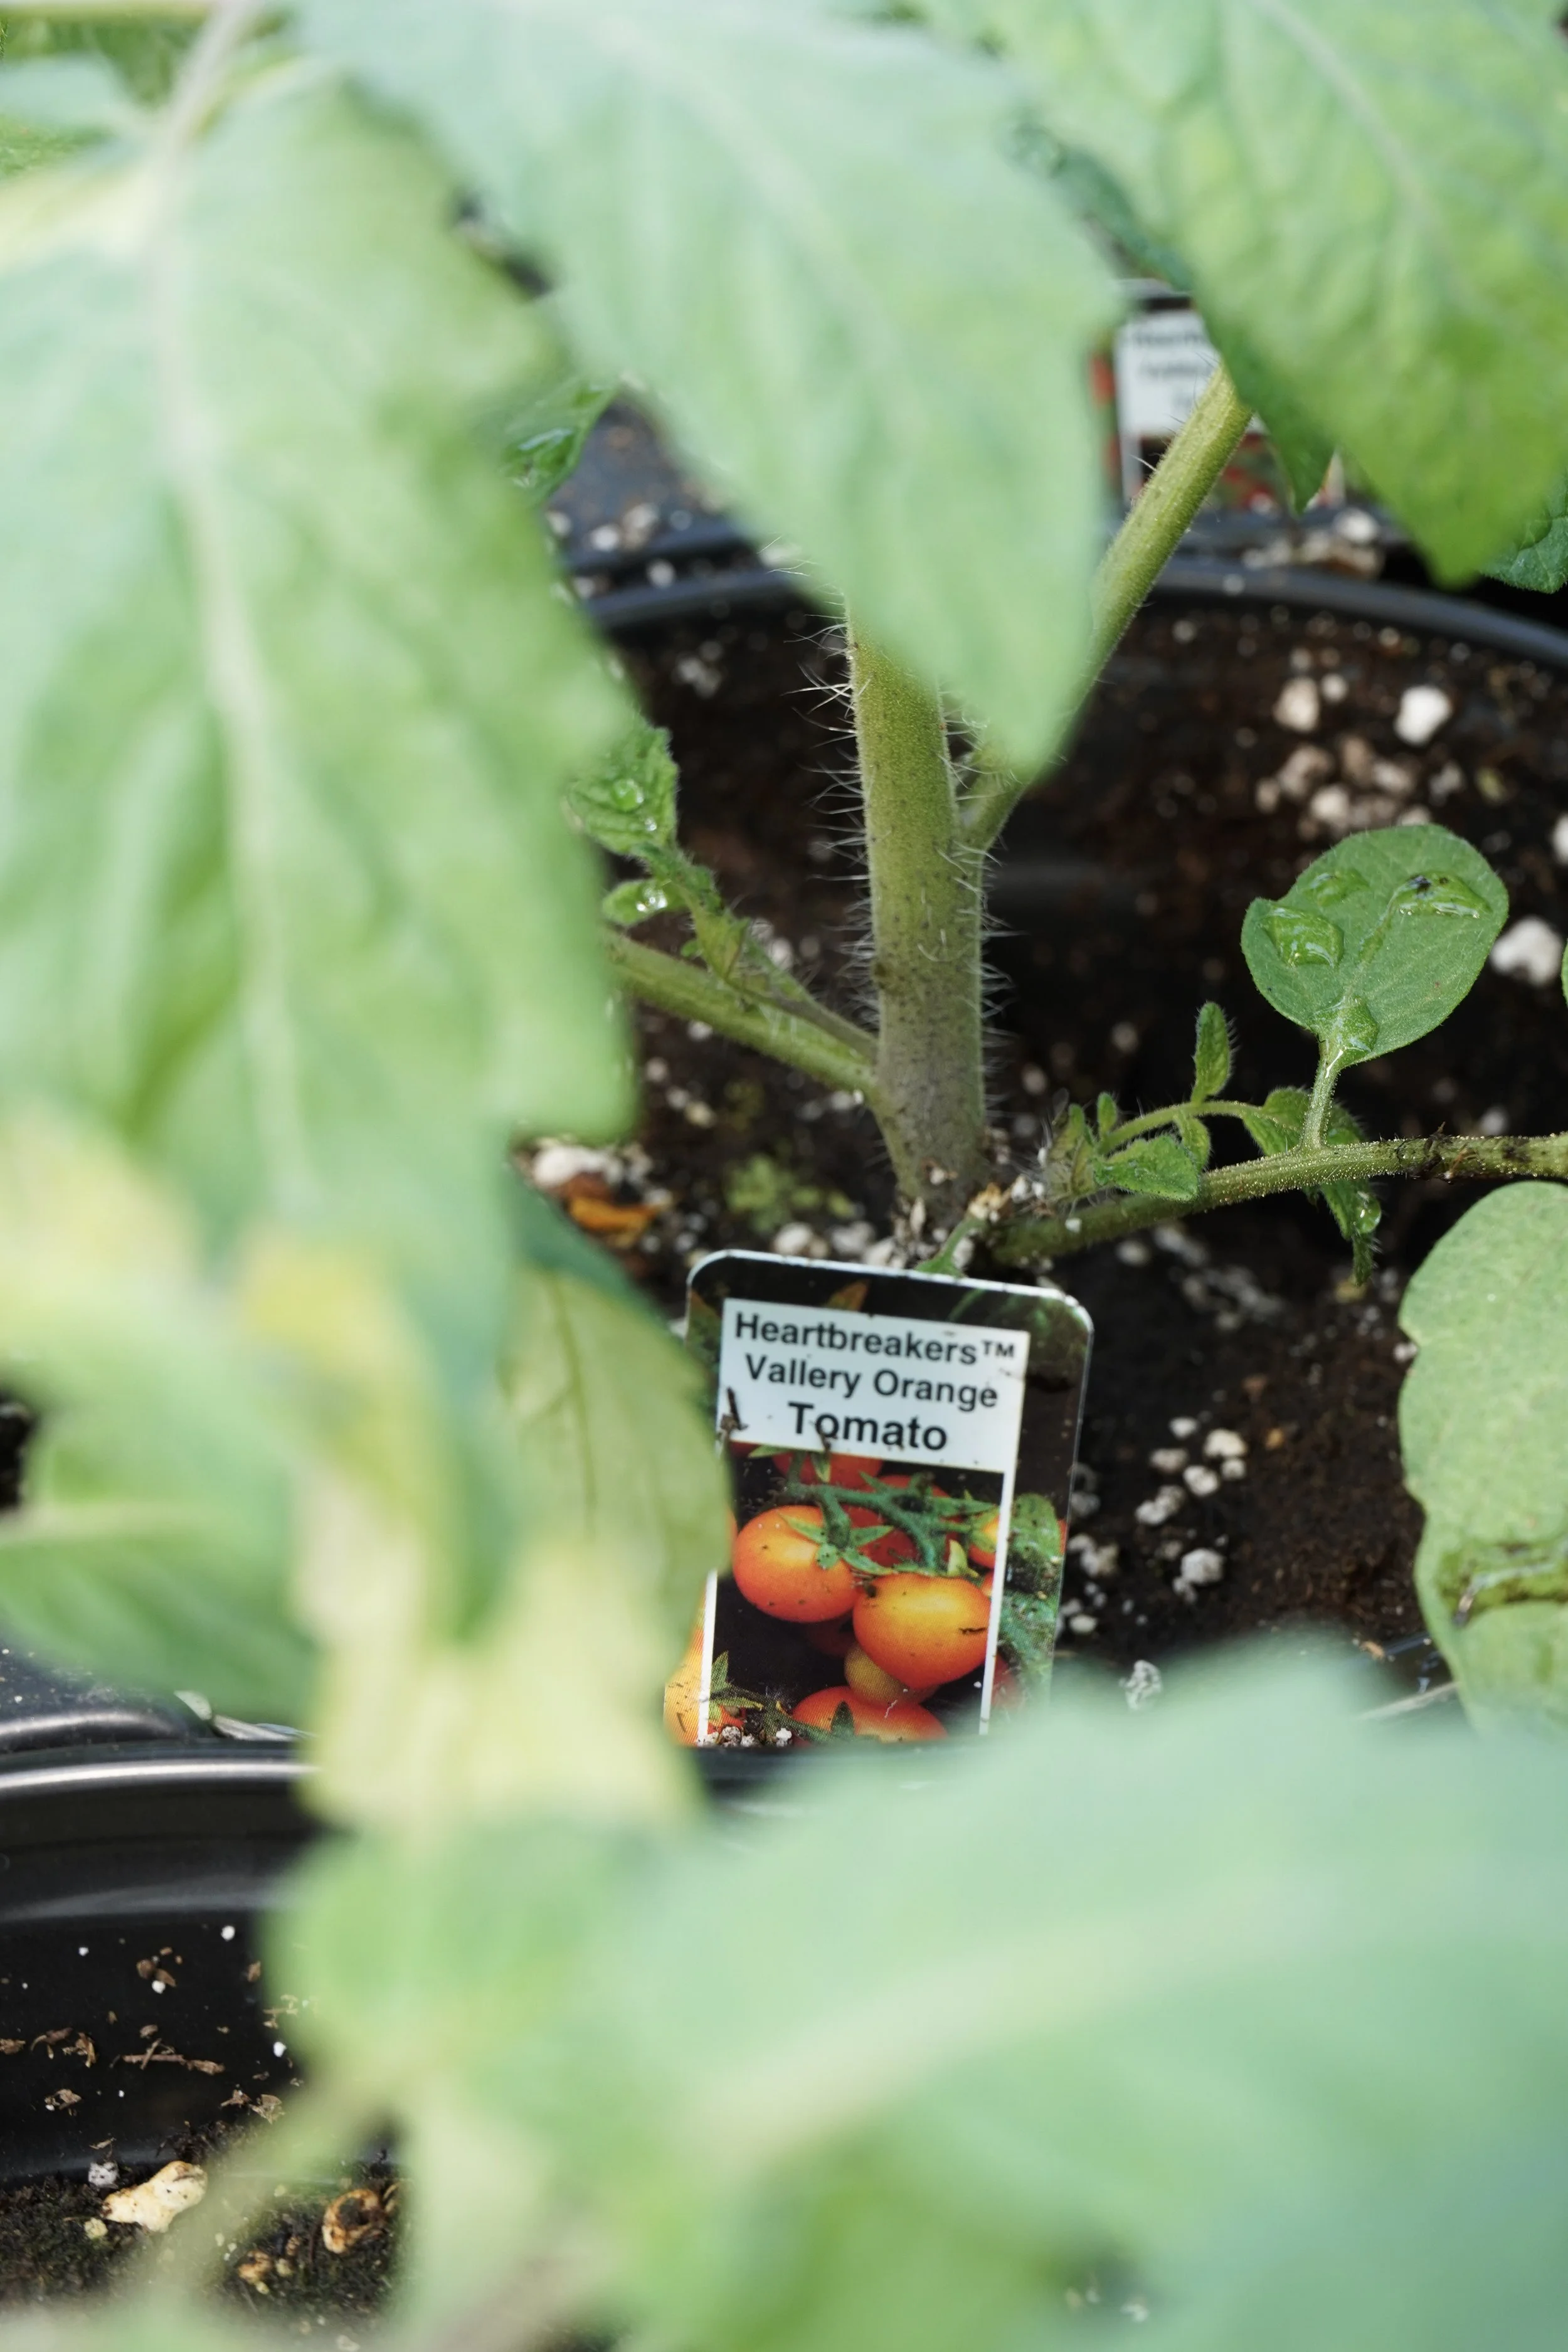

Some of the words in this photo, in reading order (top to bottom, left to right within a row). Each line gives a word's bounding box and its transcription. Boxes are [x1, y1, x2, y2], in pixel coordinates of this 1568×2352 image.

[746, 1354, 861, 1398] Vallery
[874, 1369, 998, 1412] Orange
[788, 1402, 947, 1451] Tomato
